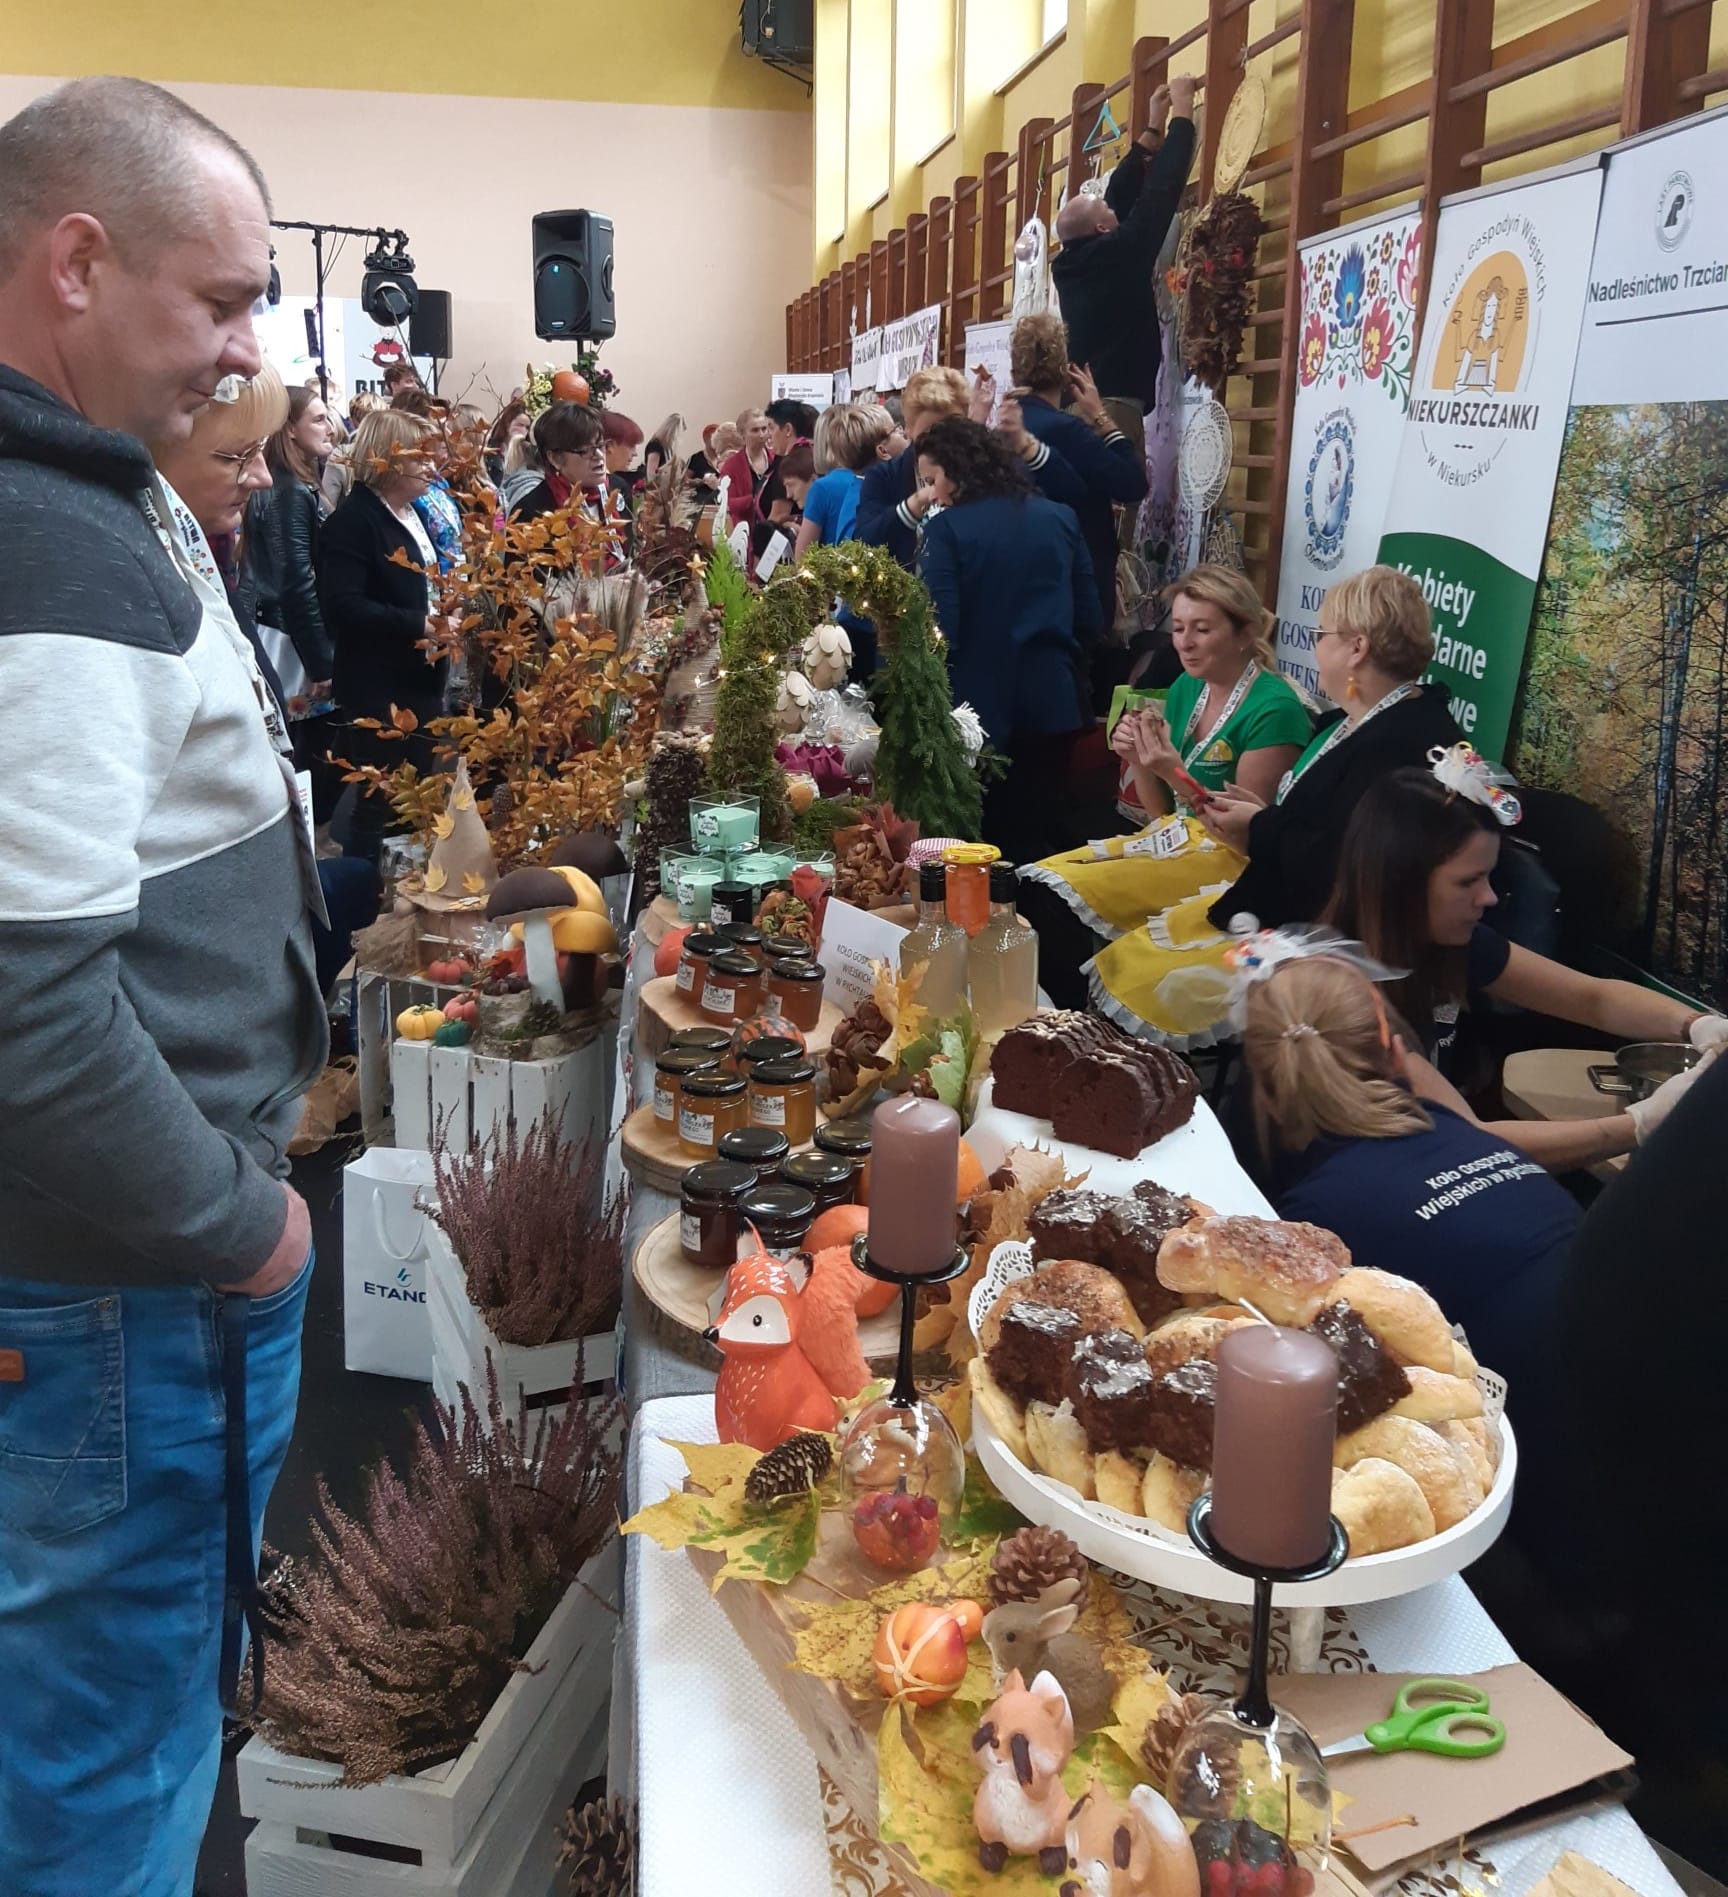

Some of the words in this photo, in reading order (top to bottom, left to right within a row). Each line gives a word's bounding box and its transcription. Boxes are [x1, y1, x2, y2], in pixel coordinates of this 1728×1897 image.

[1588, 272, 1679, 303] Nadleśnictwo
[355, 379, 385, 397] BIT
[1406, 399, 1540, 431] NIEKURSZCZANKI
[1437, 458, 1491, 487] Niekursku
[1414, 1175, 1493, 1221] Wiejskich
